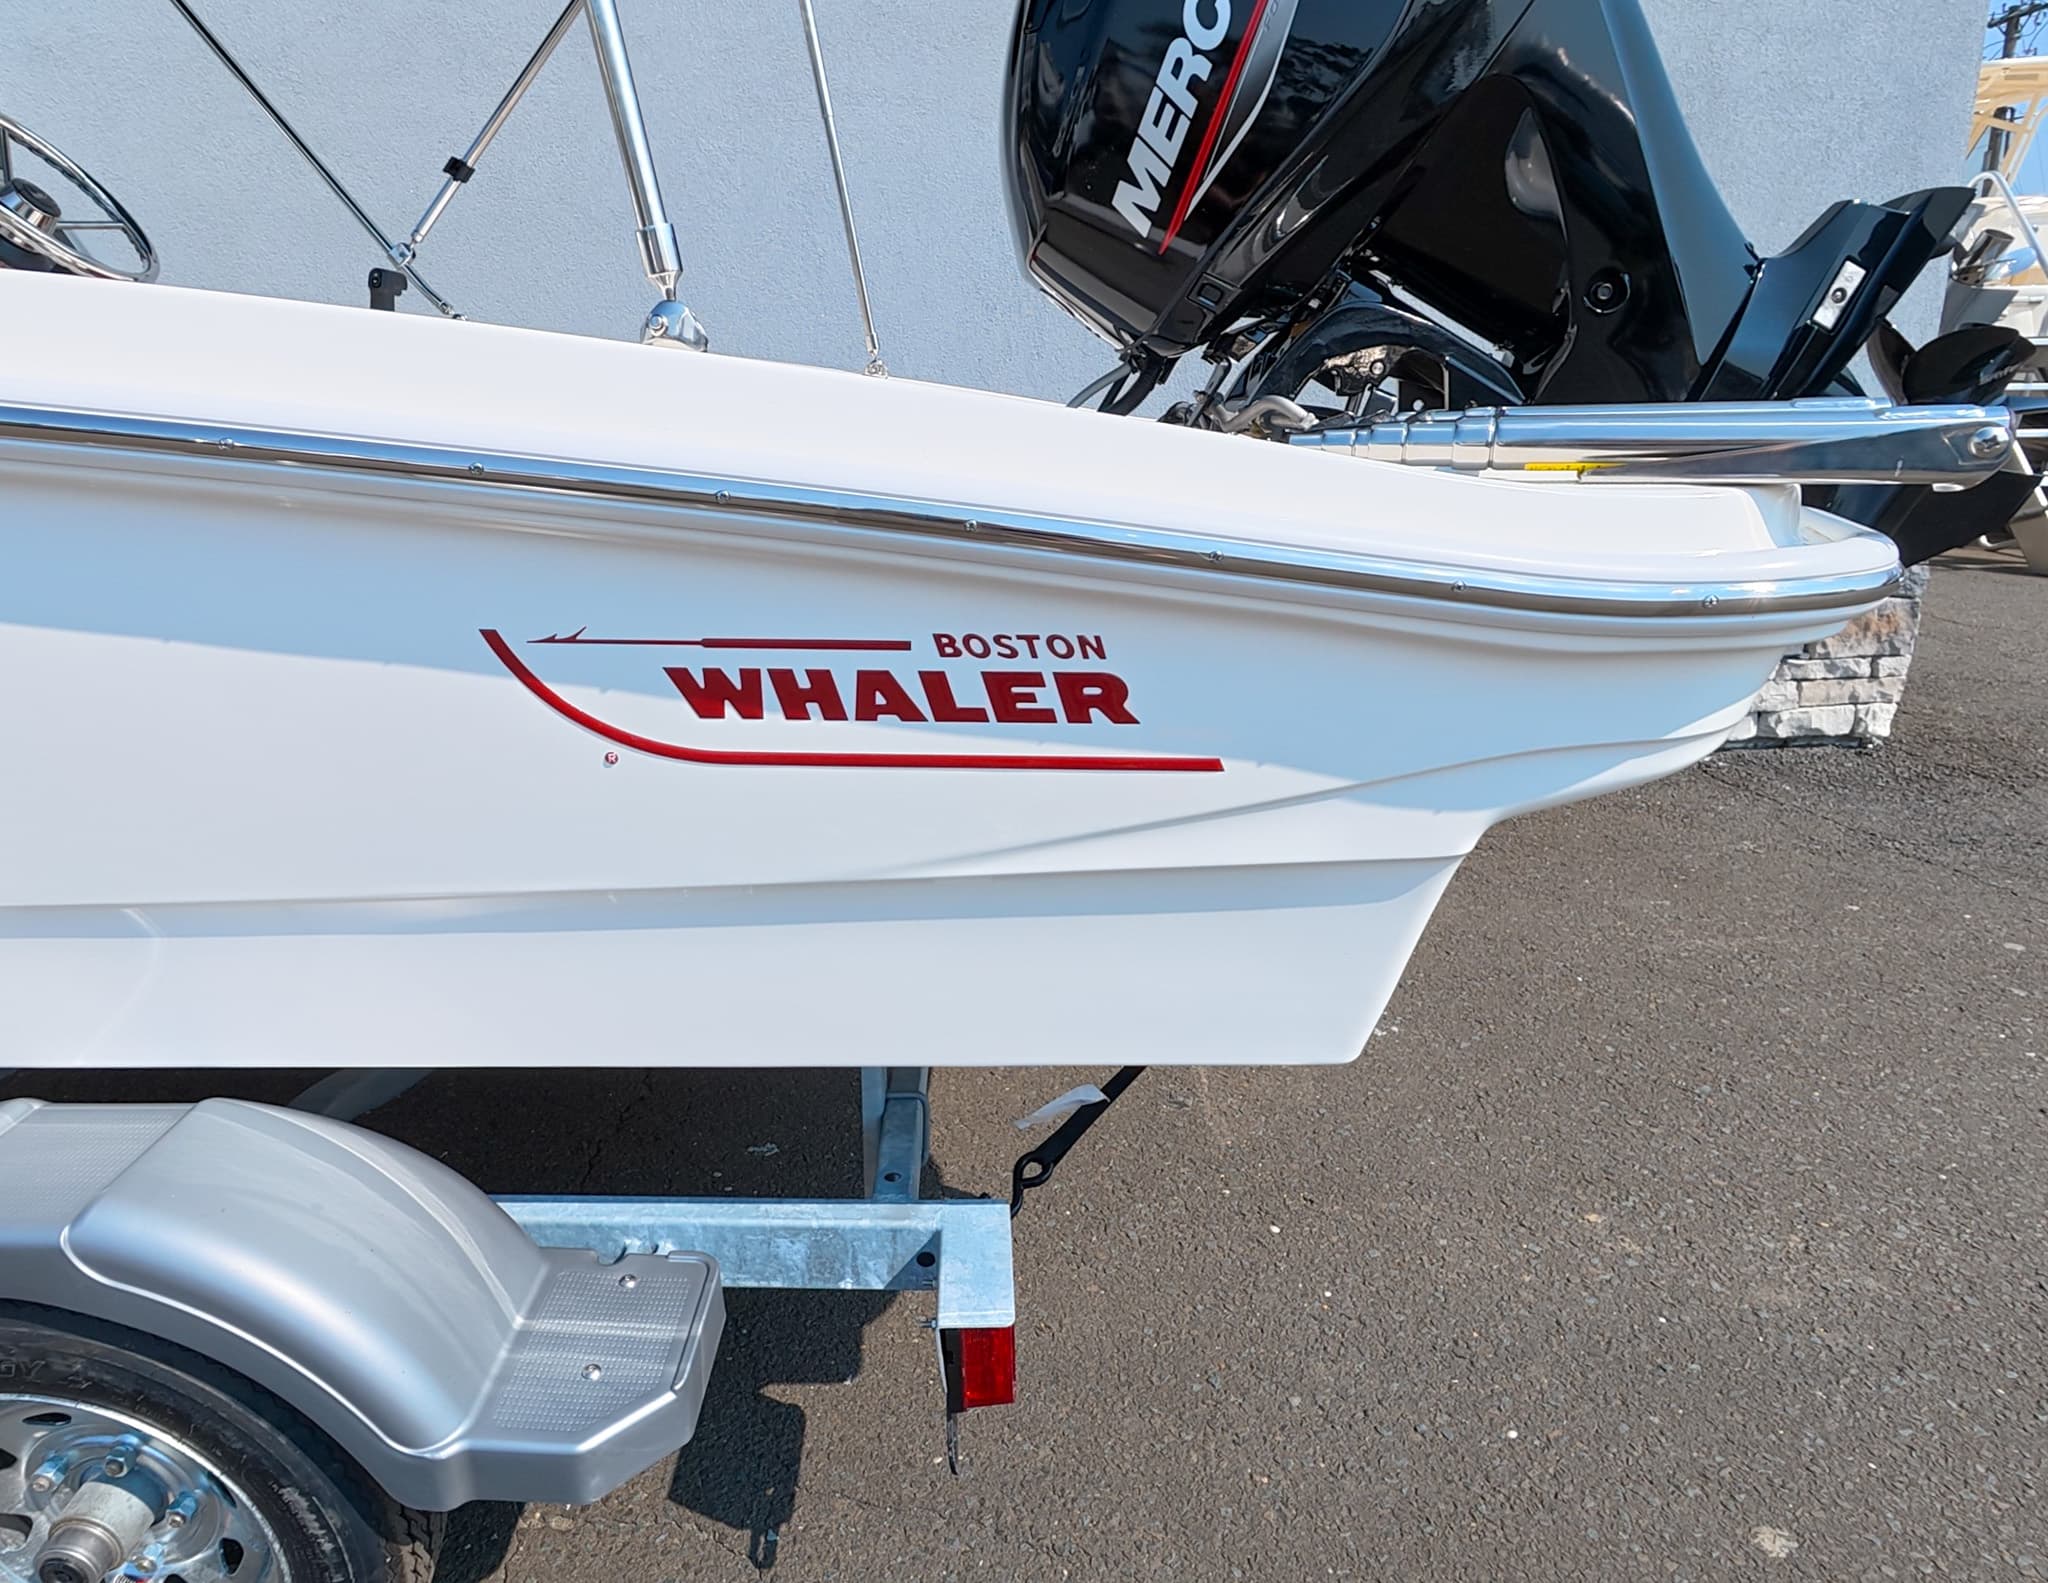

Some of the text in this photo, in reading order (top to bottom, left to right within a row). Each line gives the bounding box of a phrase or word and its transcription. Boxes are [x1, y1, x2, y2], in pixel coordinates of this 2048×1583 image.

[1112, 0, 1231, 238] MERC
[933, 633, 1106, 660] BOSTON
[663, 667, 1140, 725] WHALER
